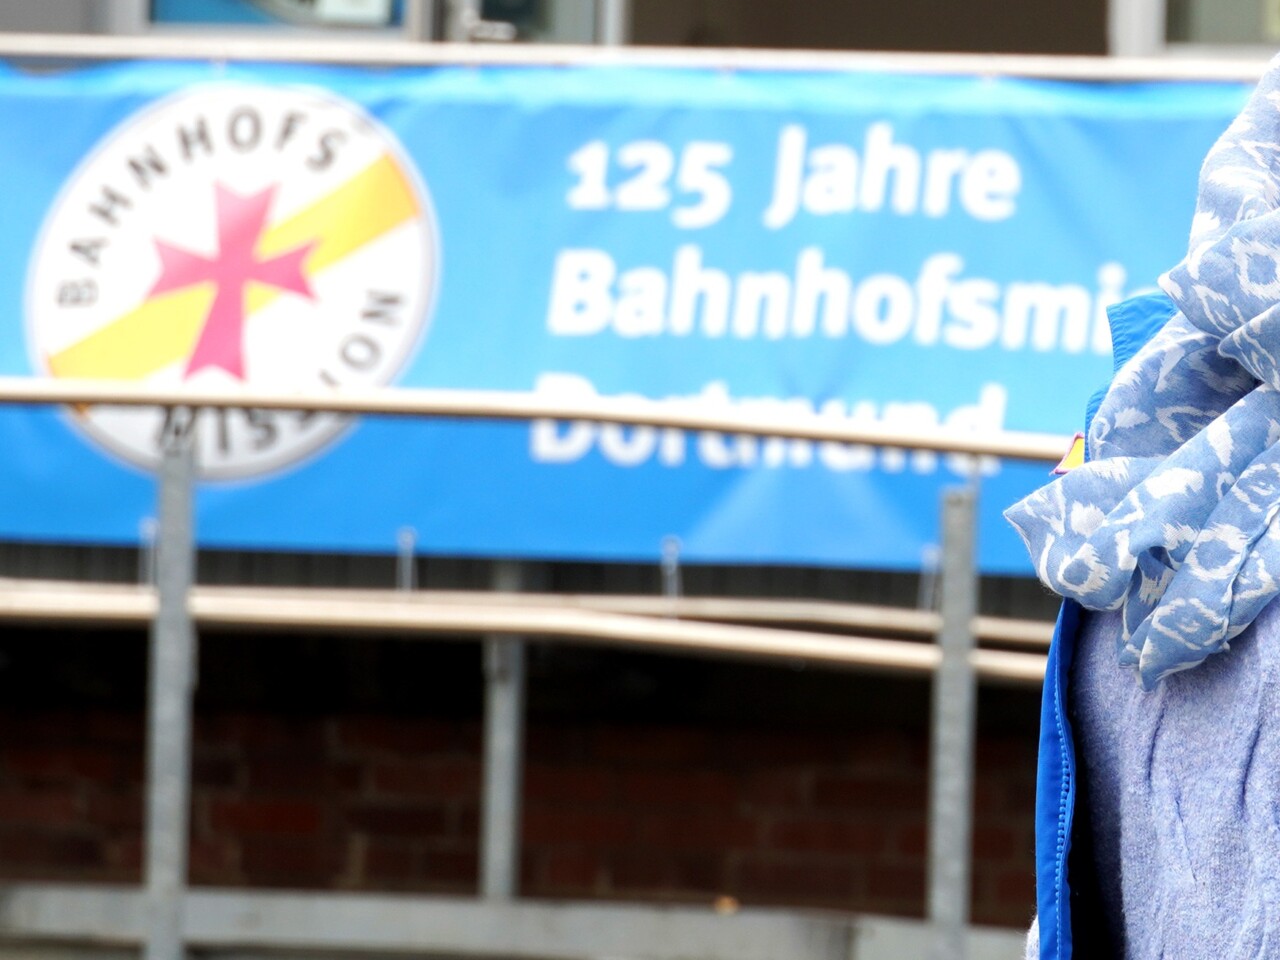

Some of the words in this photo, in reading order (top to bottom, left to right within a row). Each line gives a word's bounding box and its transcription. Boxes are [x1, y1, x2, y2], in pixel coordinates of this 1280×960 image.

[57, 104, 349, 310] BAHNHOFS
[565, 138, 735, 229] 125
[762, 120, 1022, 230] Jahre
[546, 243, 1160, 355] Bahnhofsmi
